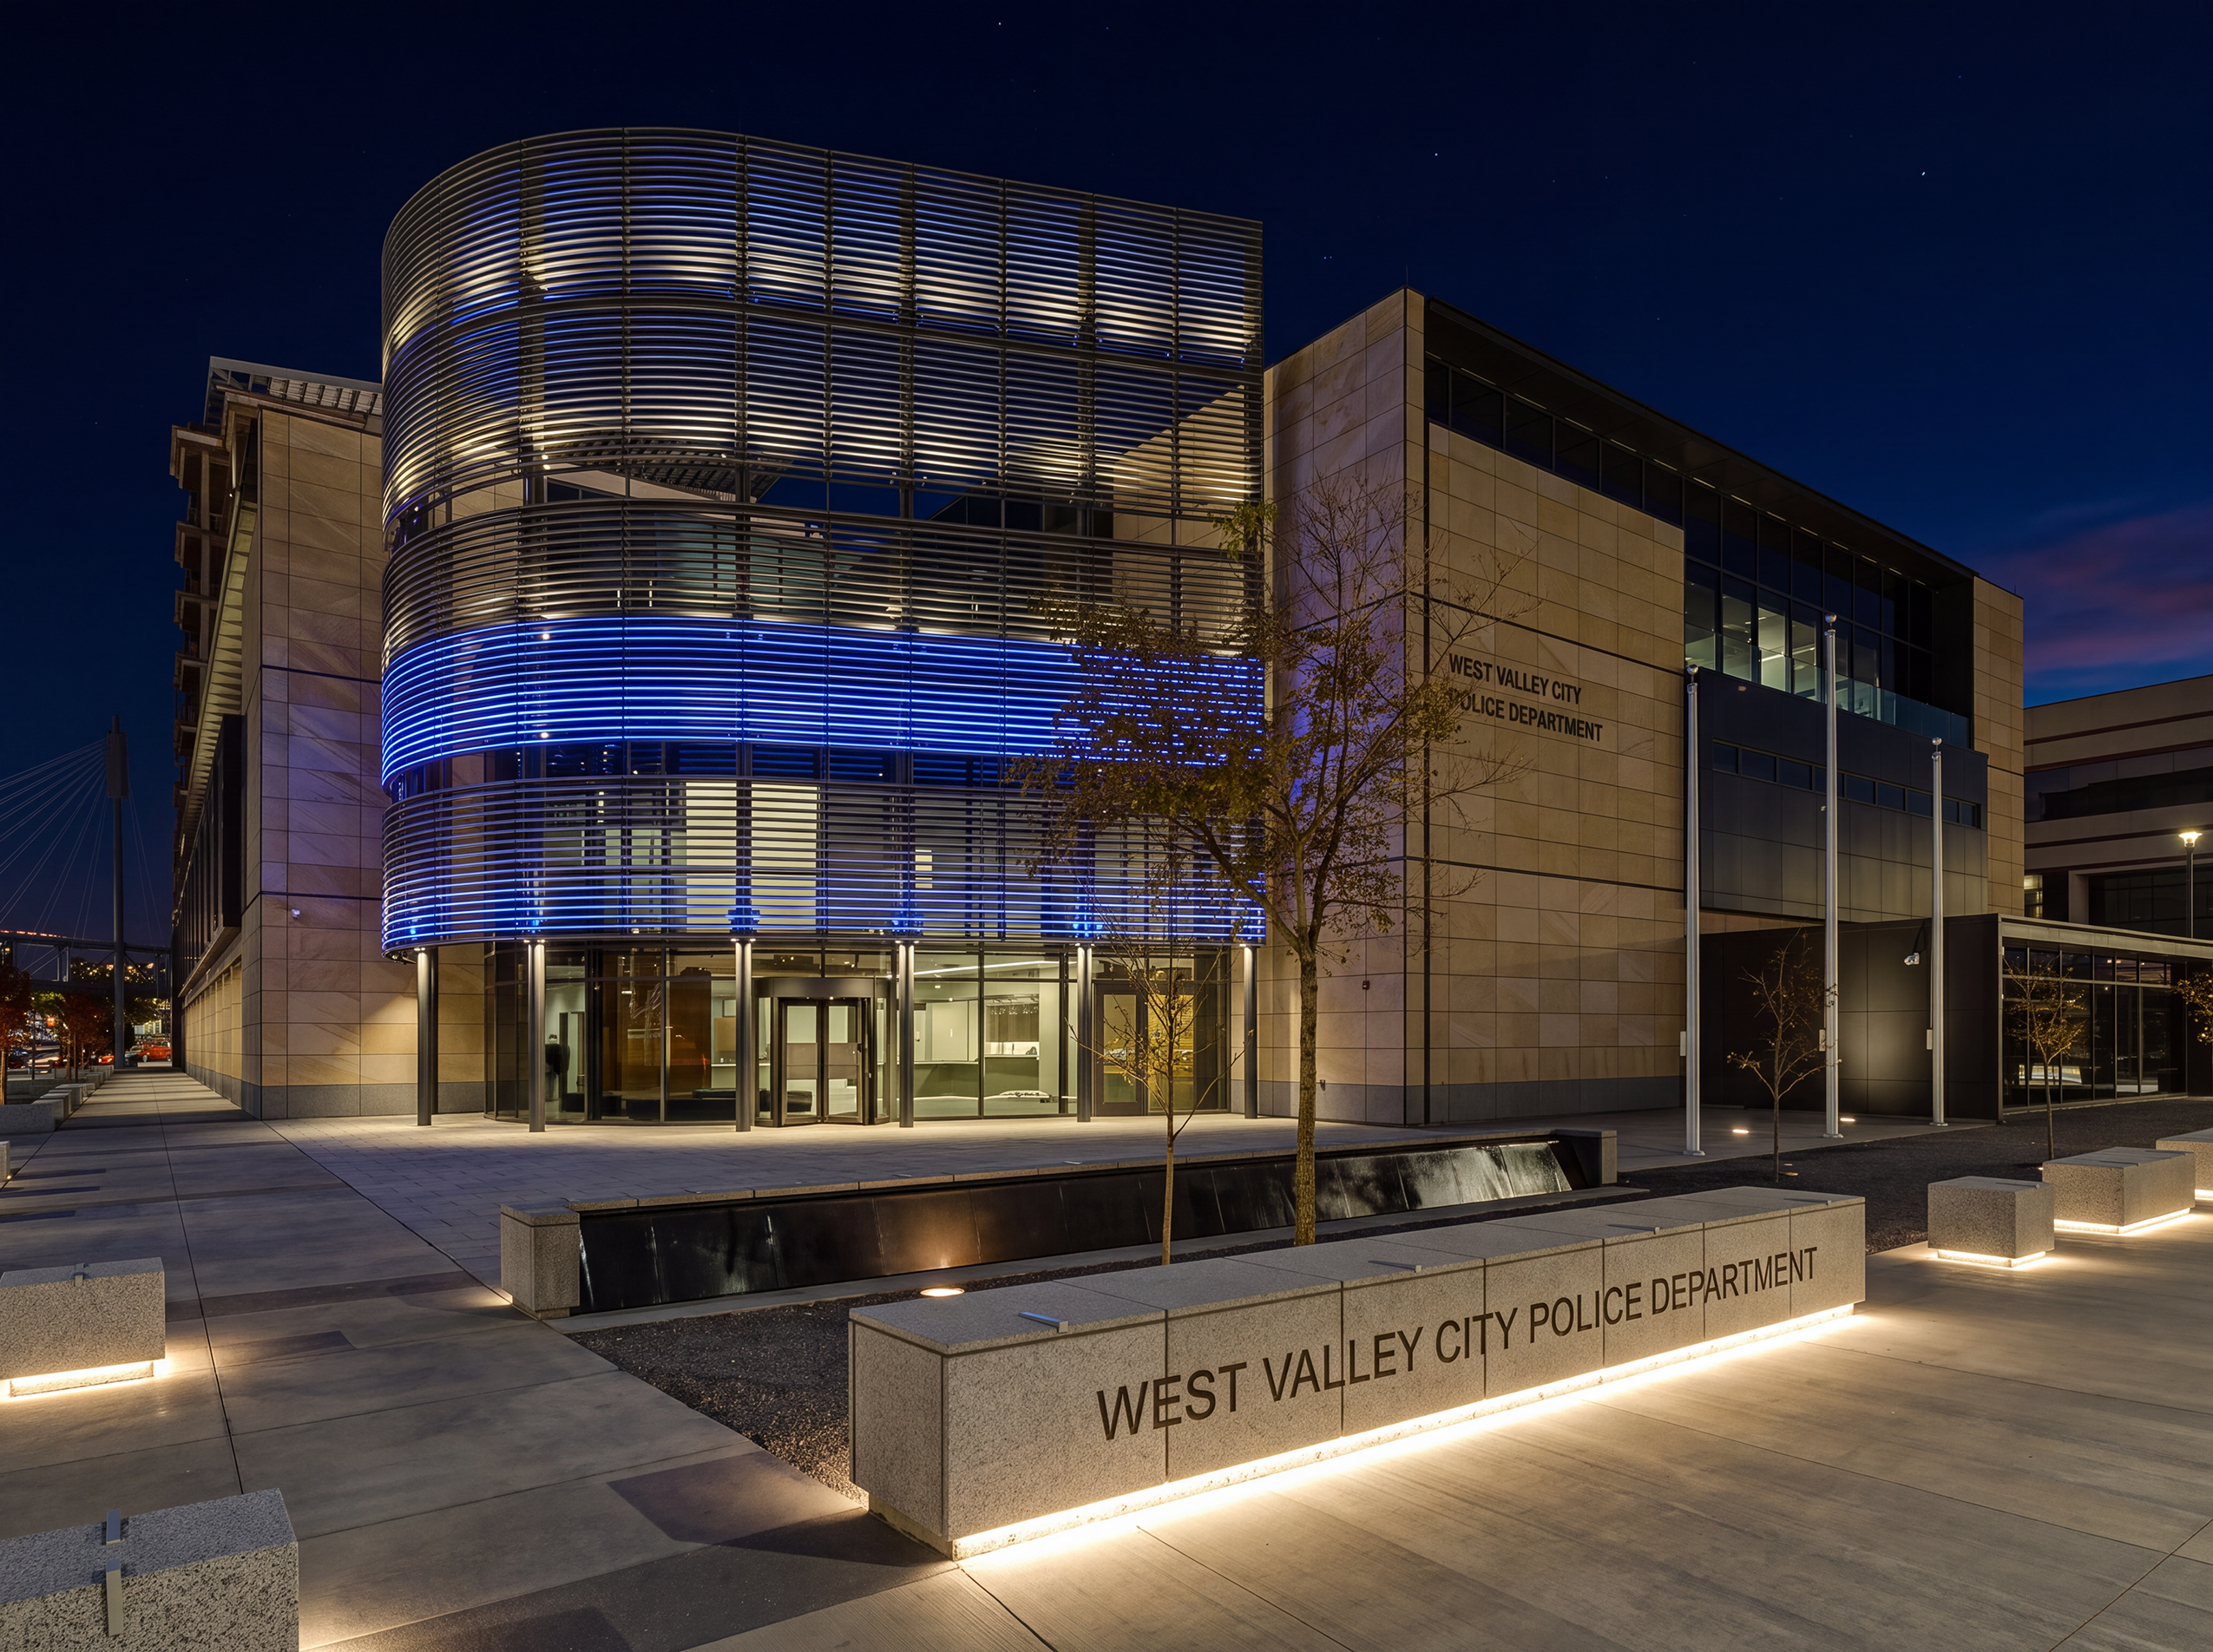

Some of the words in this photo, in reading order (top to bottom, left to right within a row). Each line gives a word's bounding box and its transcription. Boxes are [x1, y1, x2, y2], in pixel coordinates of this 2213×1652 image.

[1449, 653, 1492, 681] WEST
[1497, 665, 1549, 696] VALLEY
[1552, 681, 1581, 704] CITY
[1451, 692, 1505, 718] OLICE
[1509, 703, 1603, 741] DEPARTMENT
[1096, 1361, 1247, 1440] WEST
[1263, 1327, 1423, 1401] VALLEY
[1436, 1308, 1519, 1363] CITY
[1530, 1282, 1642, 1344] POLICE
[1652, 1247, 1818, 1315] DEPARTMENT
